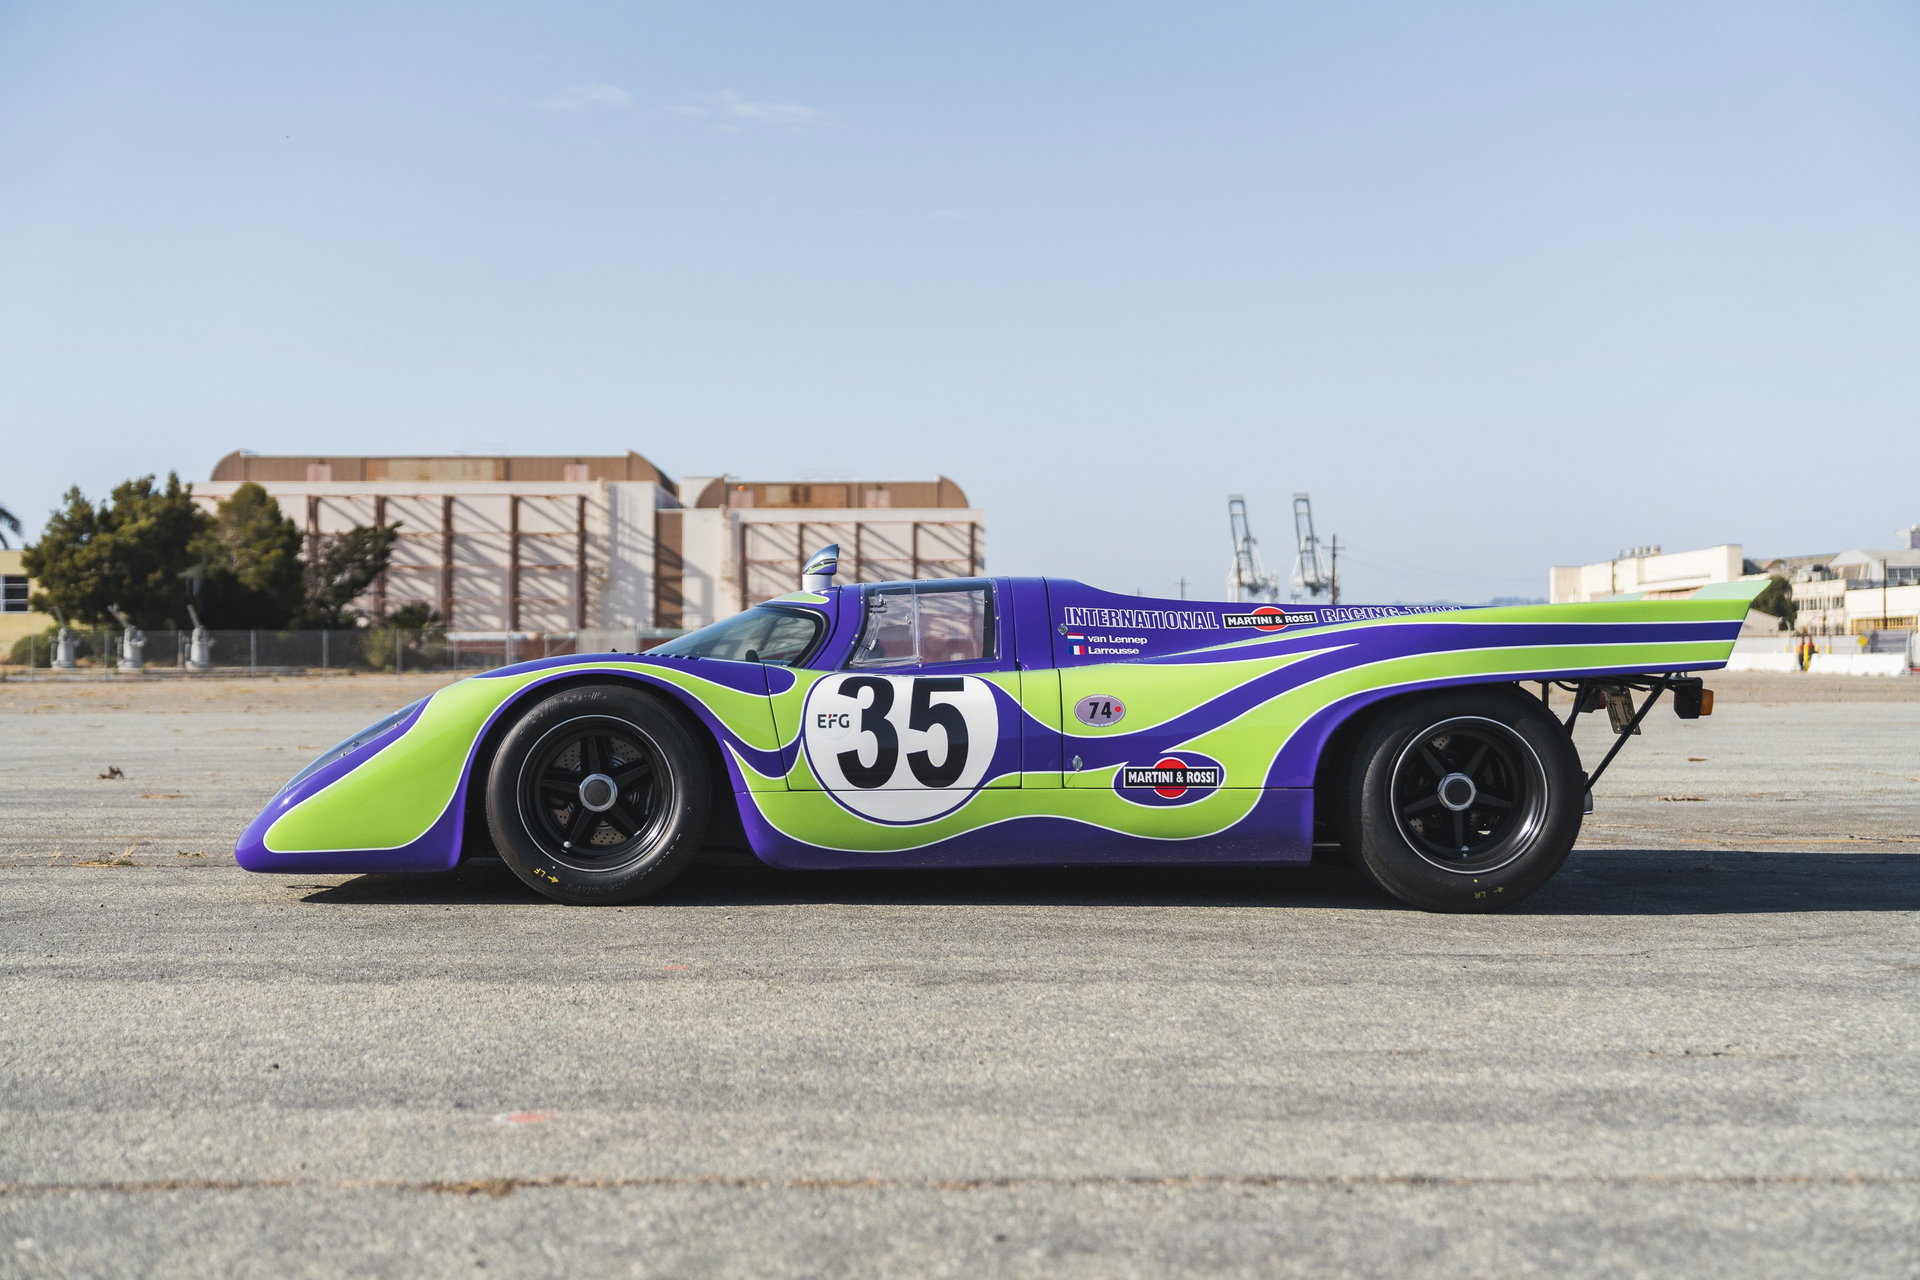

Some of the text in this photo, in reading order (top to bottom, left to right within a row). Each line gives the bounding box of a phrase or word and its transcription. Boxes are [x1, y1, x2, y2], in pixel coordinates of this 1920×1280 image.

[1064, 606, 1220, 630] INTERNATIONAL
[1227, 616, 1273, 626] MARTINI
[1275, 615, 1283, 624] &
[1285, 614, 1314, 623] ROSSI
[1087, 634, 1148, 646] van Lennep
[1088, 645, 1140, 655] Larrousse
[1089, 701, 1112, 720] 74
[817, 713, 850, 729] EFG
[836, 676, 969, 789] 35
[1128, 771, 1215, 784] MARTINI & ROSSI
